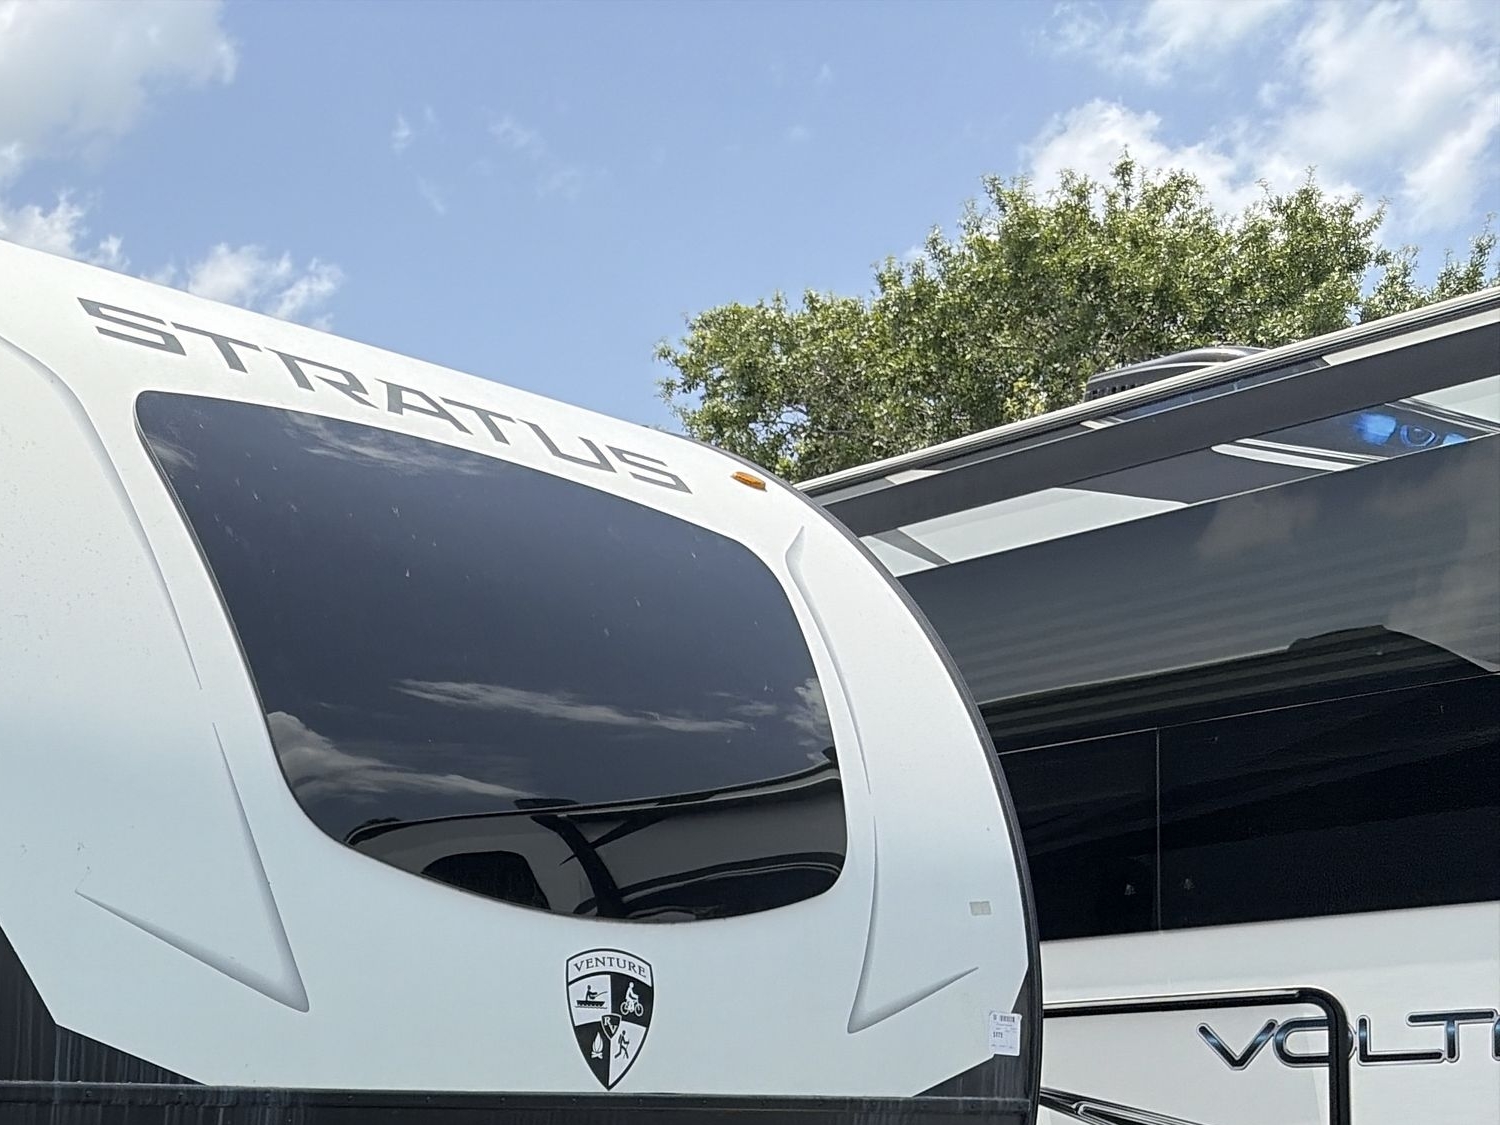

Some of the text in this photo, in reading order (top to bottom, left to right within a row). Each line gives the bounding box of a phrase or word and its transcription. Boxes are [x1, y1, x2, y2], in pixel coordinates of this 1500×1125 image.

[77, 297, 693, 494] STRATUS
[574, 956, 647, 978] VENTURE
[604, 1016, 618, 1035] RV
[1197, 1008, 1500, 1070] VOLT
